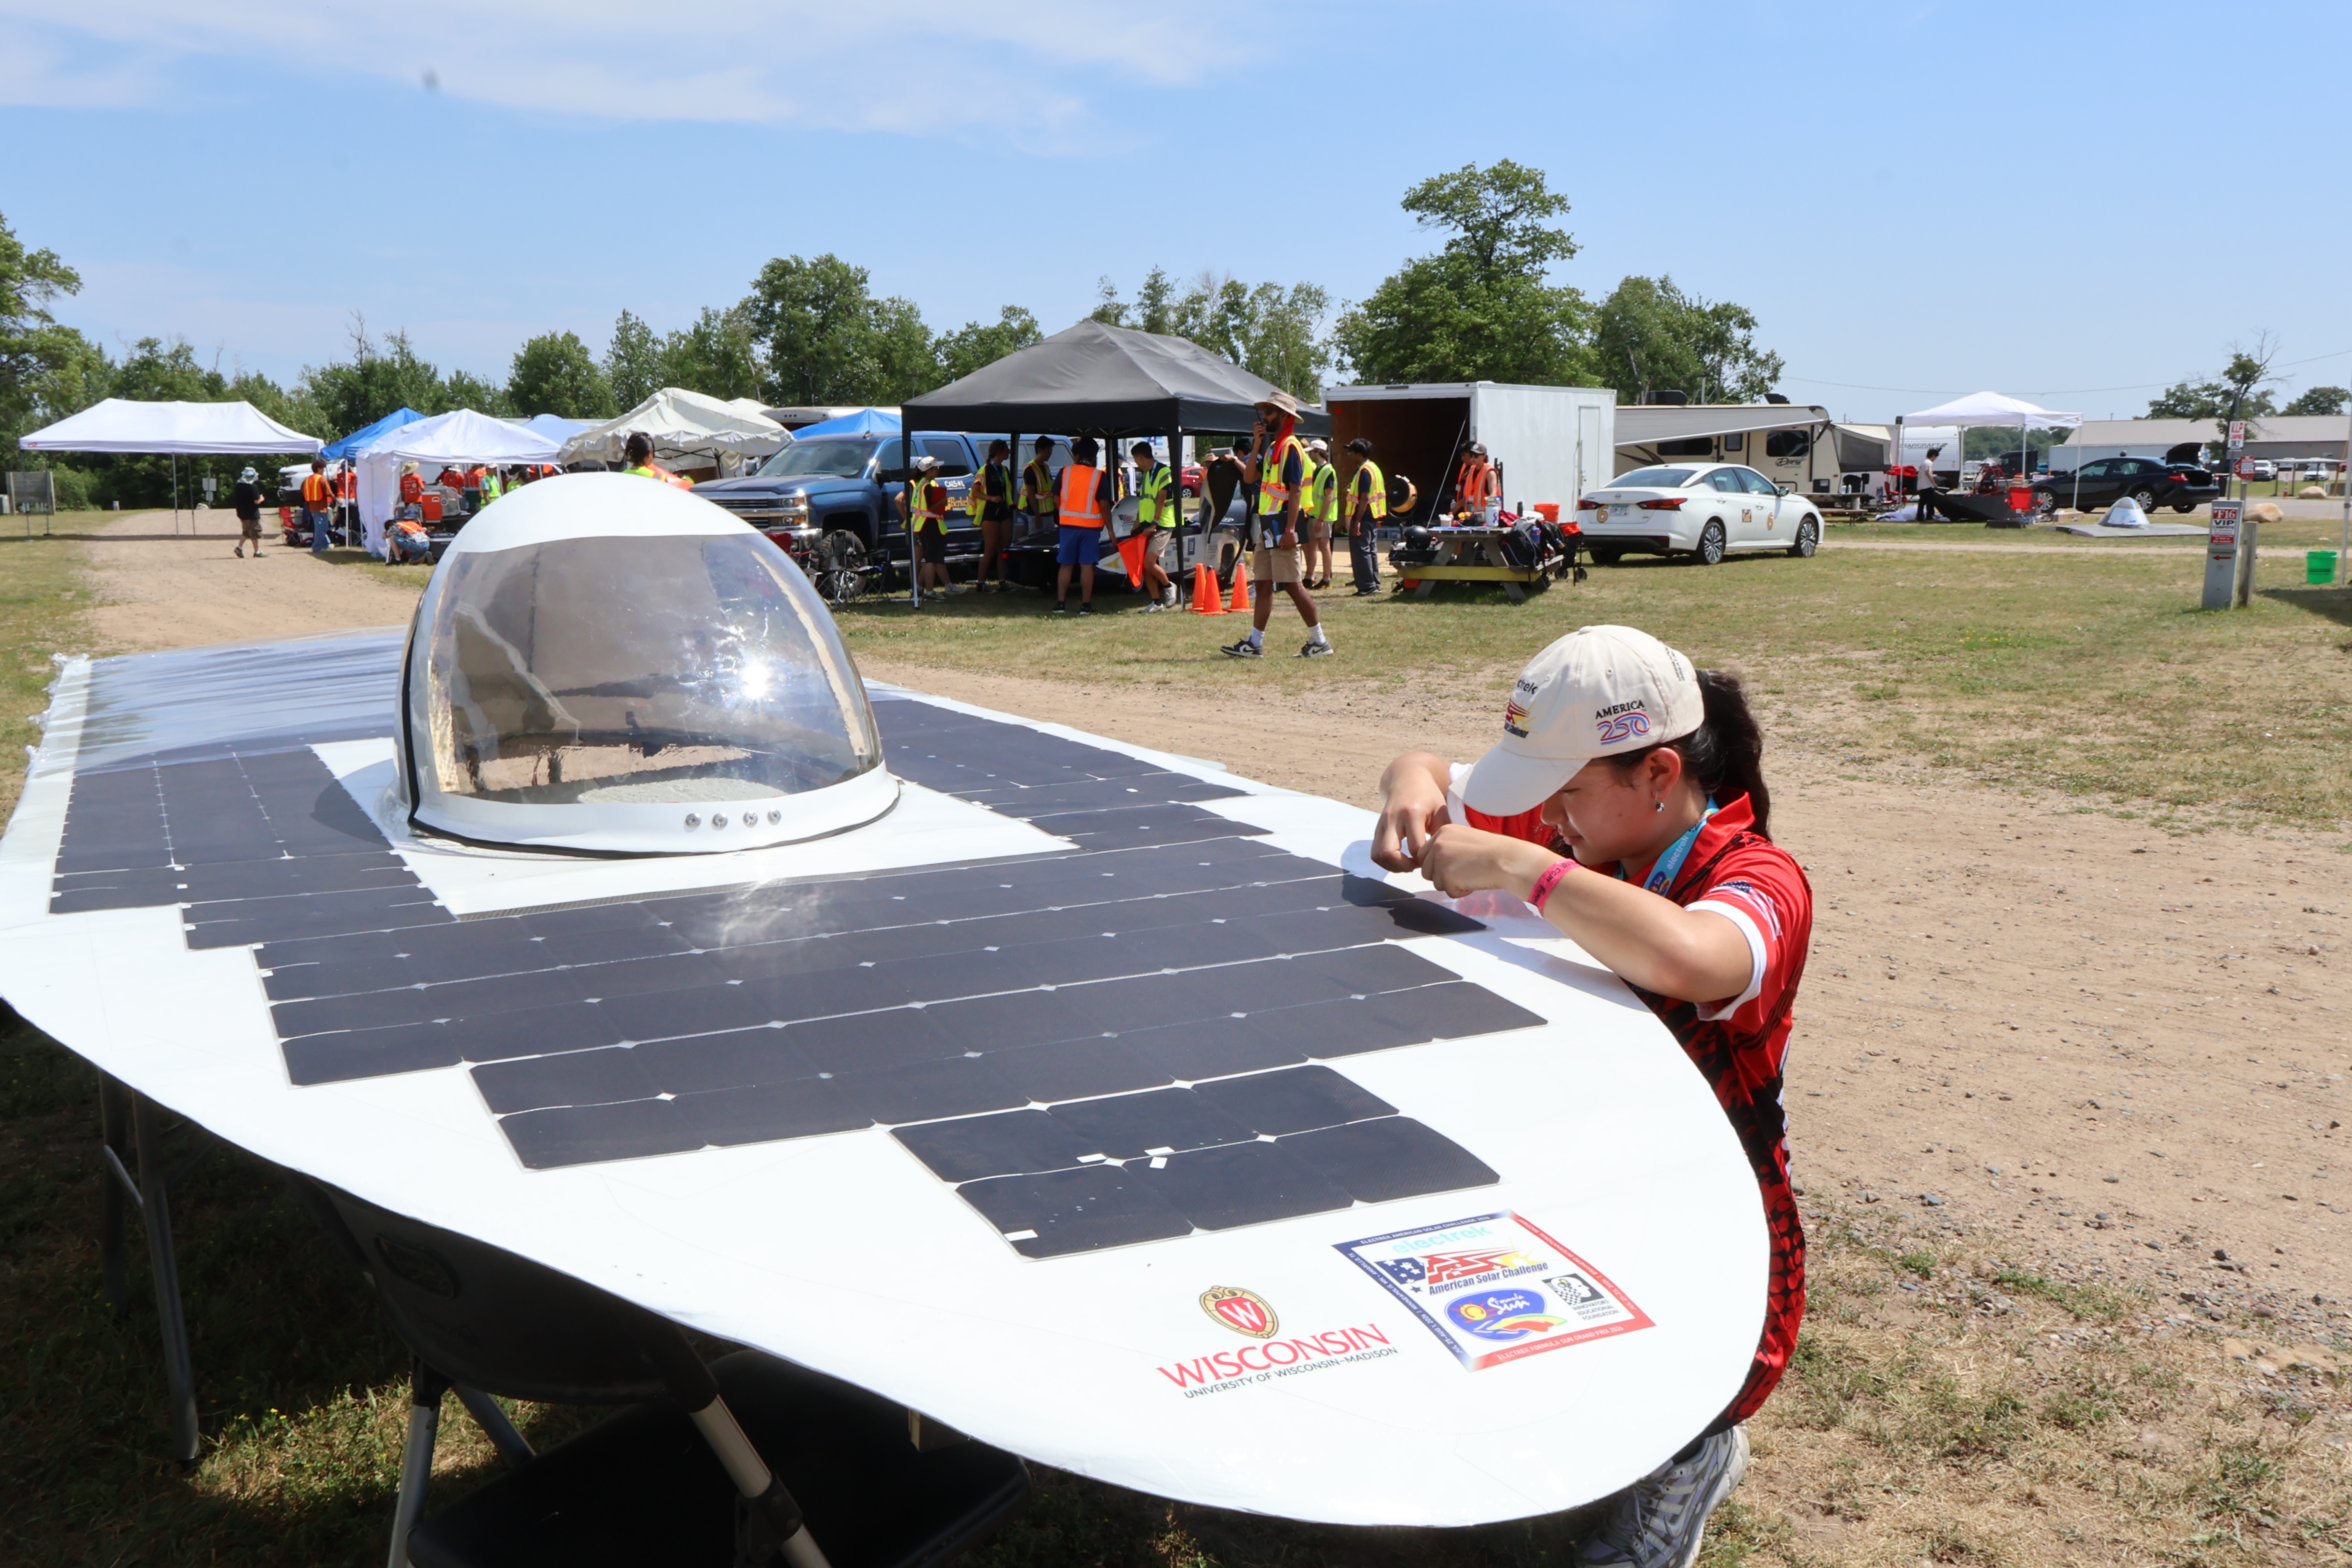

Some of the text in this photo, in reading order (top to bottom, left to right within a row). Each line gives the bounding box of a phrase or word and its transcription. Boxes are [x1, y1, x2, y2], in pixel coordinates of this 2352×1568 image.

[1597, 505, 1609, 523] 6
[1767, 512, 1774, 531] 6
[1595, 700, 1645, 719] AMERICA
[1597, 712, 1651, 745] 250
[1360, 1235, 1392, 1244] ELECTREK
[1392, 1229, 1422, 1238] AMERICAN
[1442, 1219, 1476, 1228] CHALLENGE
[1392, 1226, 1494, 1253] electrek
[1429, 1262, 1548, 1296] American Solar Challenge
[1487, 1297, 1530, 1315] Sun
[1494, 1293, 1524, 1305] Formula
[1572, 1299, 1610, 1311] INNOVATORS
[1219, 1301, 1262, 1329] W
[1421, 1314, 1433, 1324] 2026
[1577, 1305, 1615, 1316] EDUCATIONAL
[1582, 1309, 1620, 1321] FOUNDATION
[1497, 1325, 1624, 1360] ELECTREK FORMULA SUN GRAND PRIX 2026
[1156, 1323, 1391, 1388] WISCONSIN
[1184, 1376, 1254, 1399] UNIVERSITY
[1256, 1371, 1273, 1382] OF
